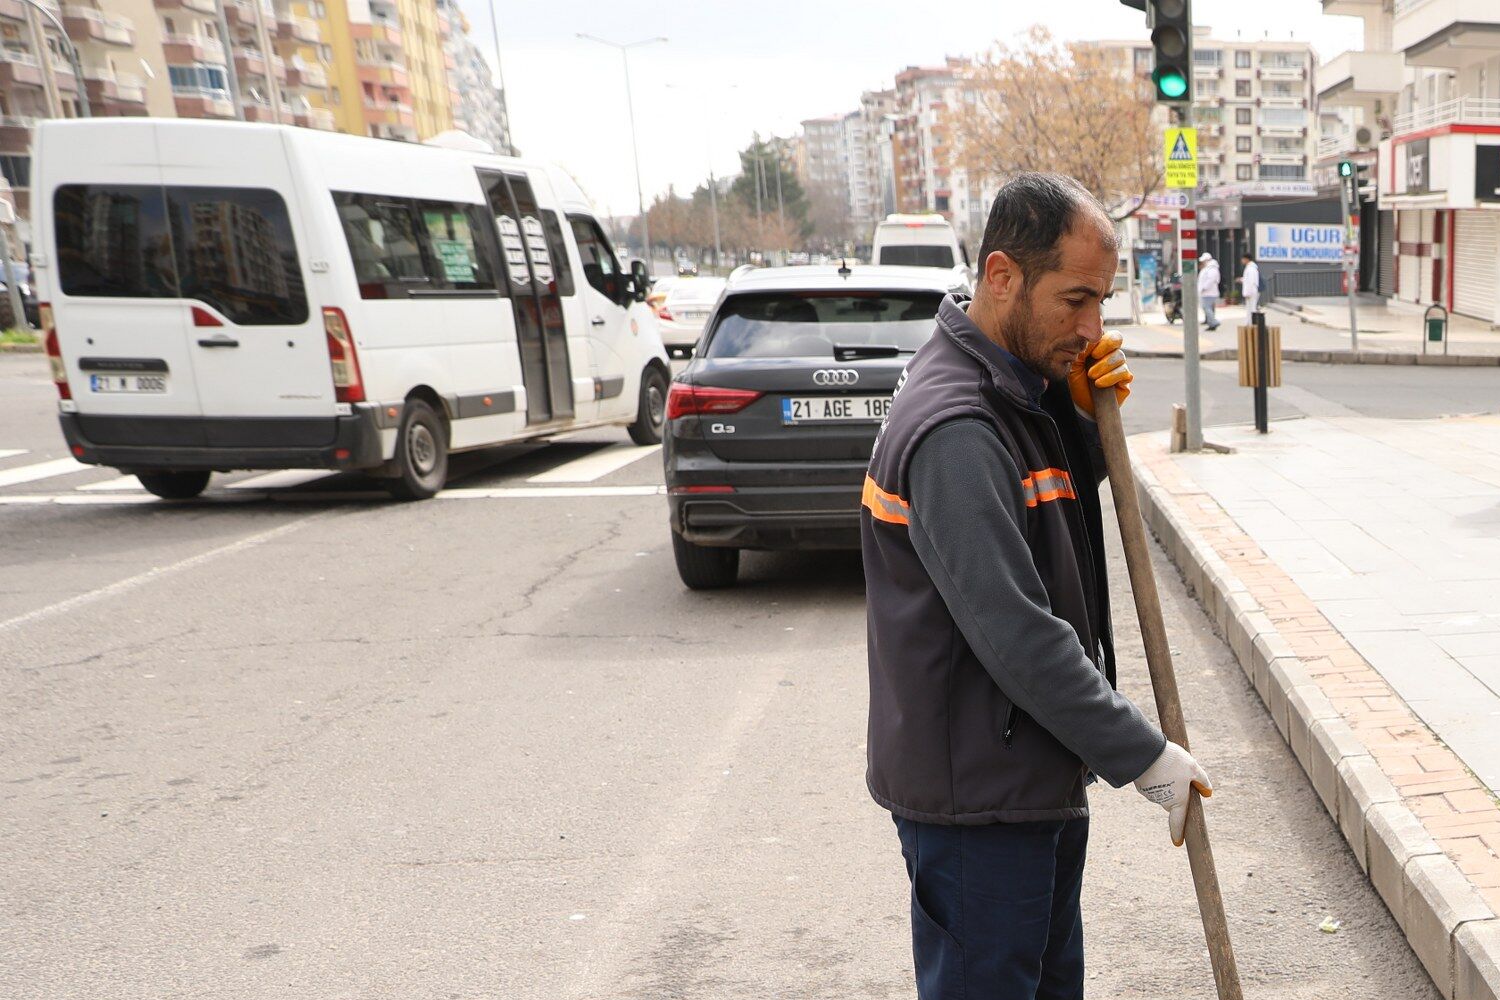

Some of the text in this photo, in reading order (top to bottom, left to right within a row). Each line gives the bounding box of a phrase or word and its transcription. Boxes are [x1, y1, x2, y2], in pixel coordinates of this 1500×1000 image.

[793, 400, 811, 418] 21
[823, 399, 853, 417] AGE
[710, 423, 736, 434] Q3
